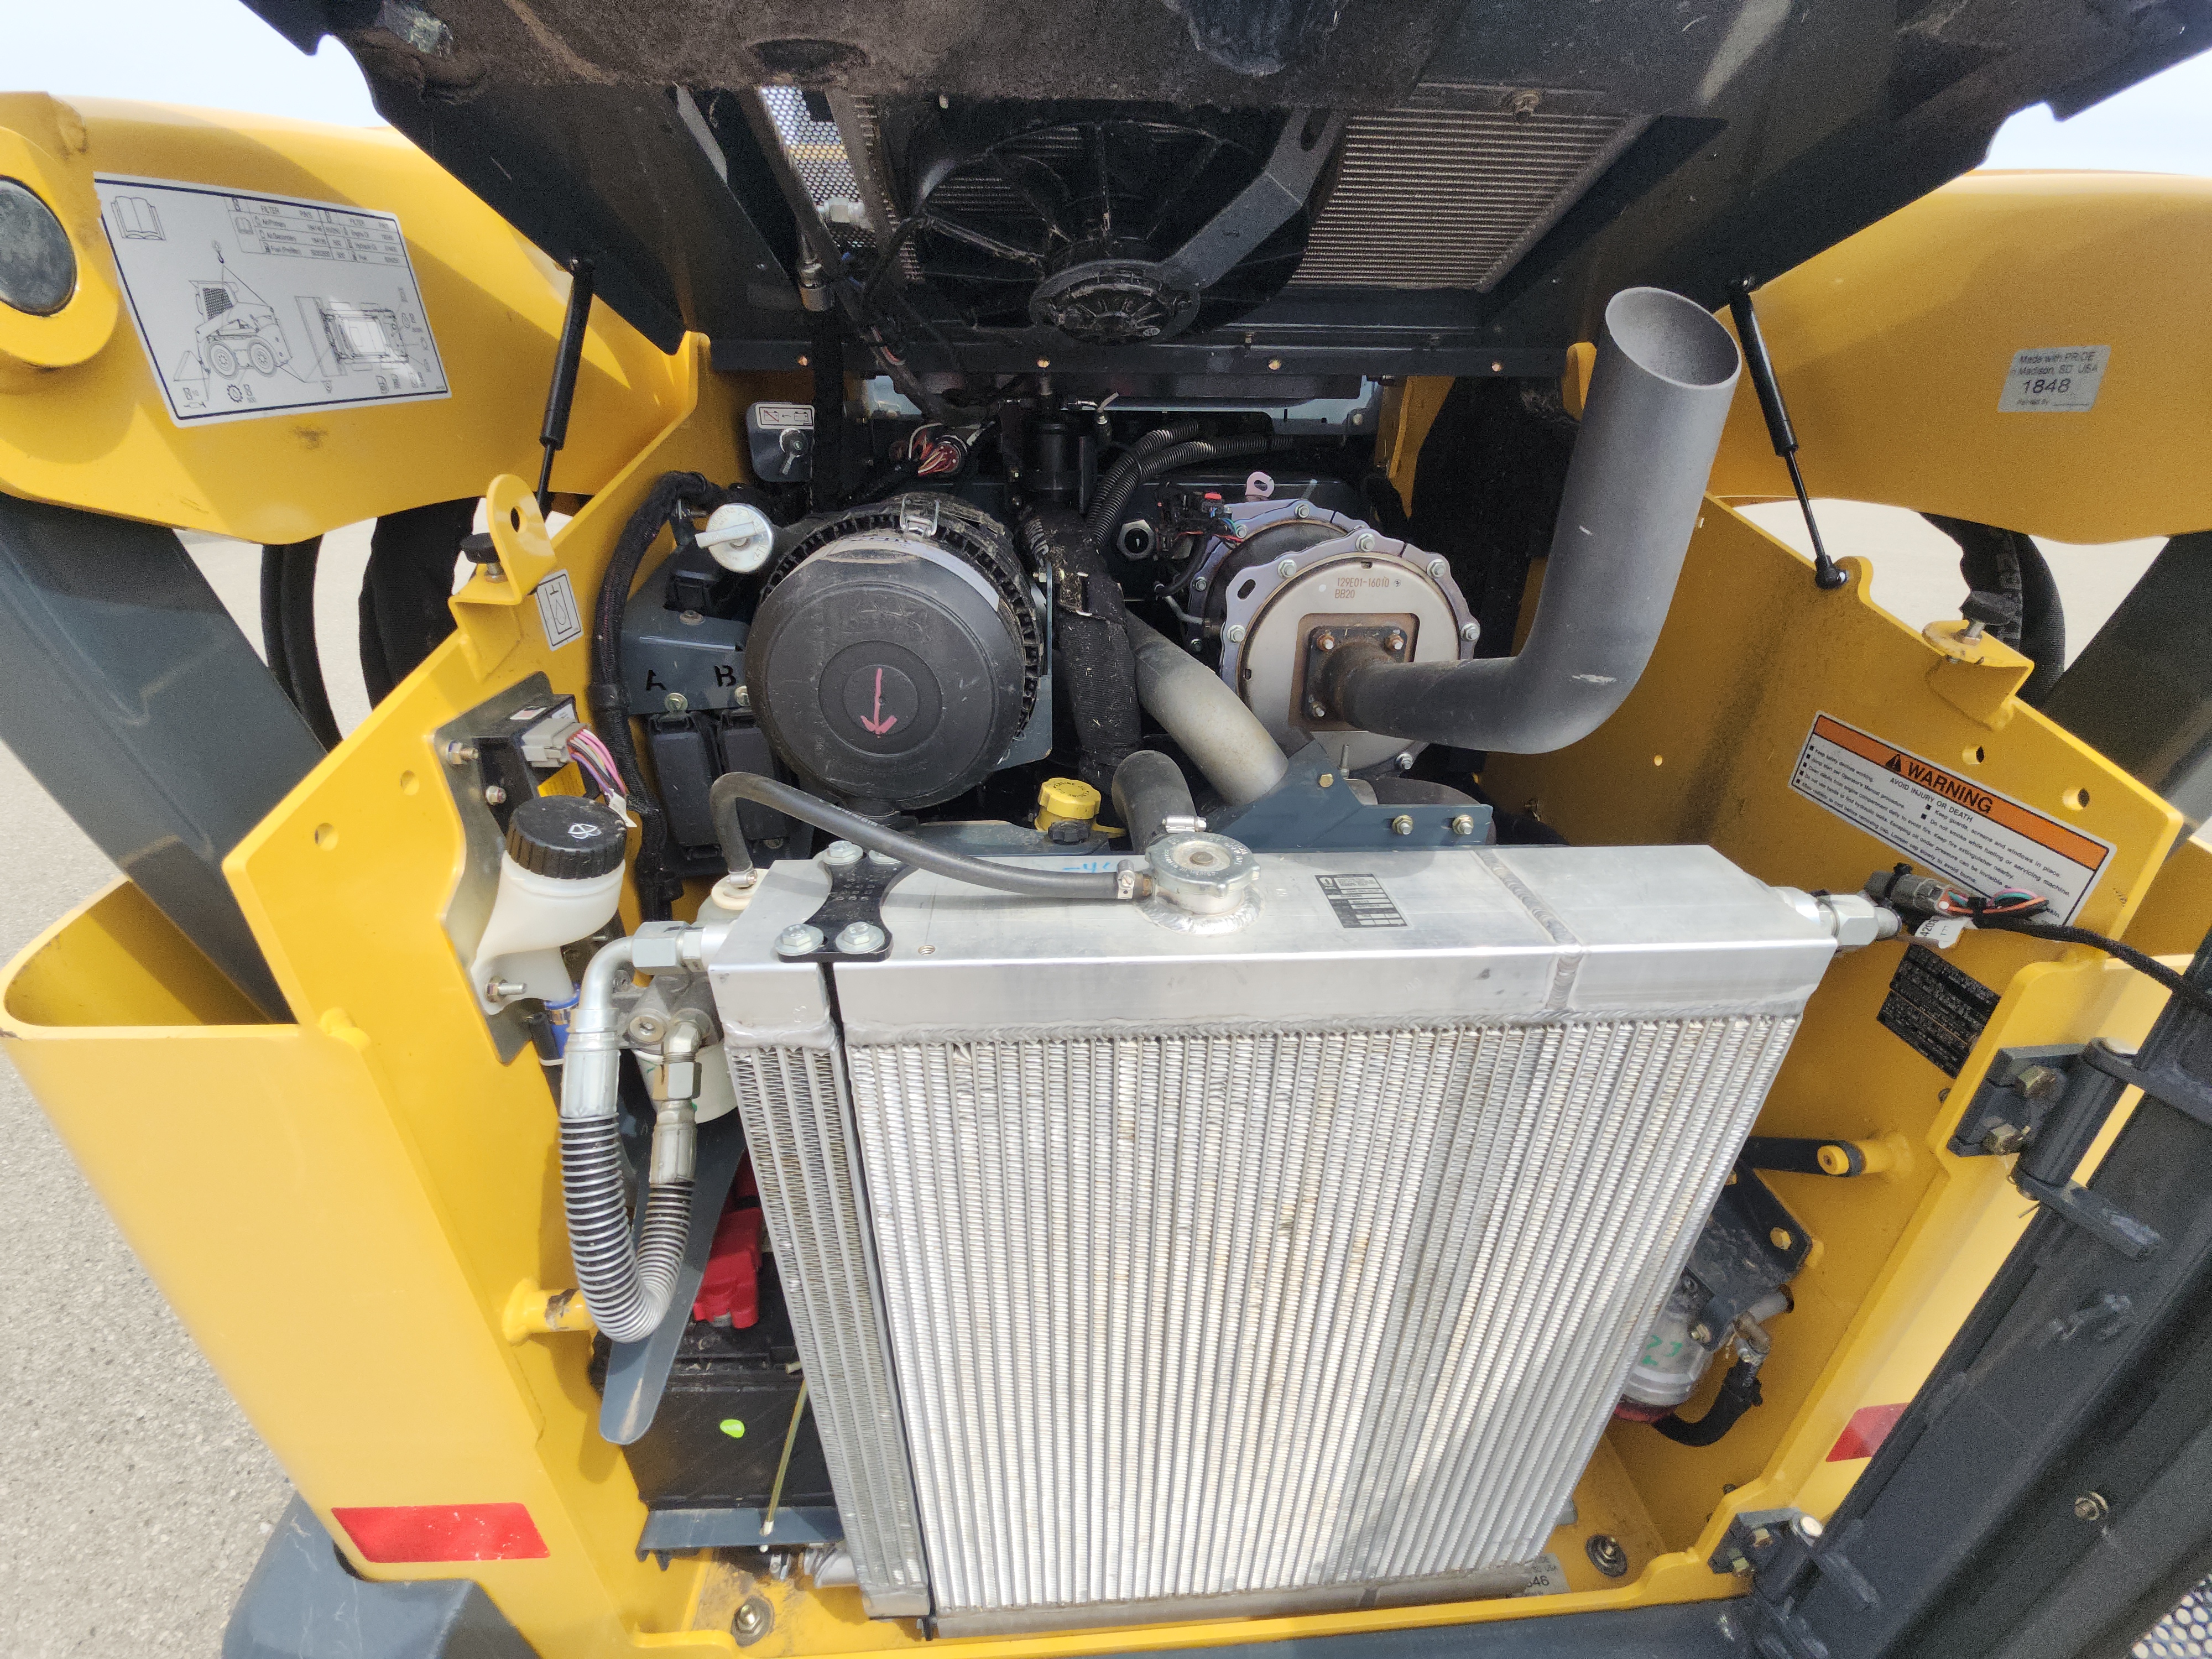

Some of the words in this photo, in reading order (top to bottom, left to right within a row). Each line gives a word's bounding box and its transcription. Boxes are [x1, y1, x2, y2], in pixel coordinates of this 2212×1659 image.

[2023, 378, 2072, 394] 1848
[1334, 589, 1355, 599] BB20
[1337, 577, 1390, 588] 129E01-16010
[645, 669, 667, 691] A
[713, 665, 737, 687] B
[1889, 777, 1910, 791] AVOID
[1910, 787, 1935, 804] INJURY
[1935, 800, 1948, 810] OR
[1948, 806, 1974, 823] DEATH
[1906, 762, 1995, 815] WARNING
[1907, 819, 1921, 829] avoid
[1933, 833, 1947, 843] Keep
[1958, 846, 1992, 868] extinguisher
[1934, 810, 1948, 820] Keep
[1970, 829, 1992, 842] screens
[1994, 840, 2006, 849] and
[2007, 847, 2033, 863] windows
[1949, 829, 1967, 841] smoke
[1968, 839, 1983, 849] while
[2013, 863, 2042, 881] servicing
[1934, 847, 1958, 862] pressure
[1979, 870, 2003, 885] invisible
